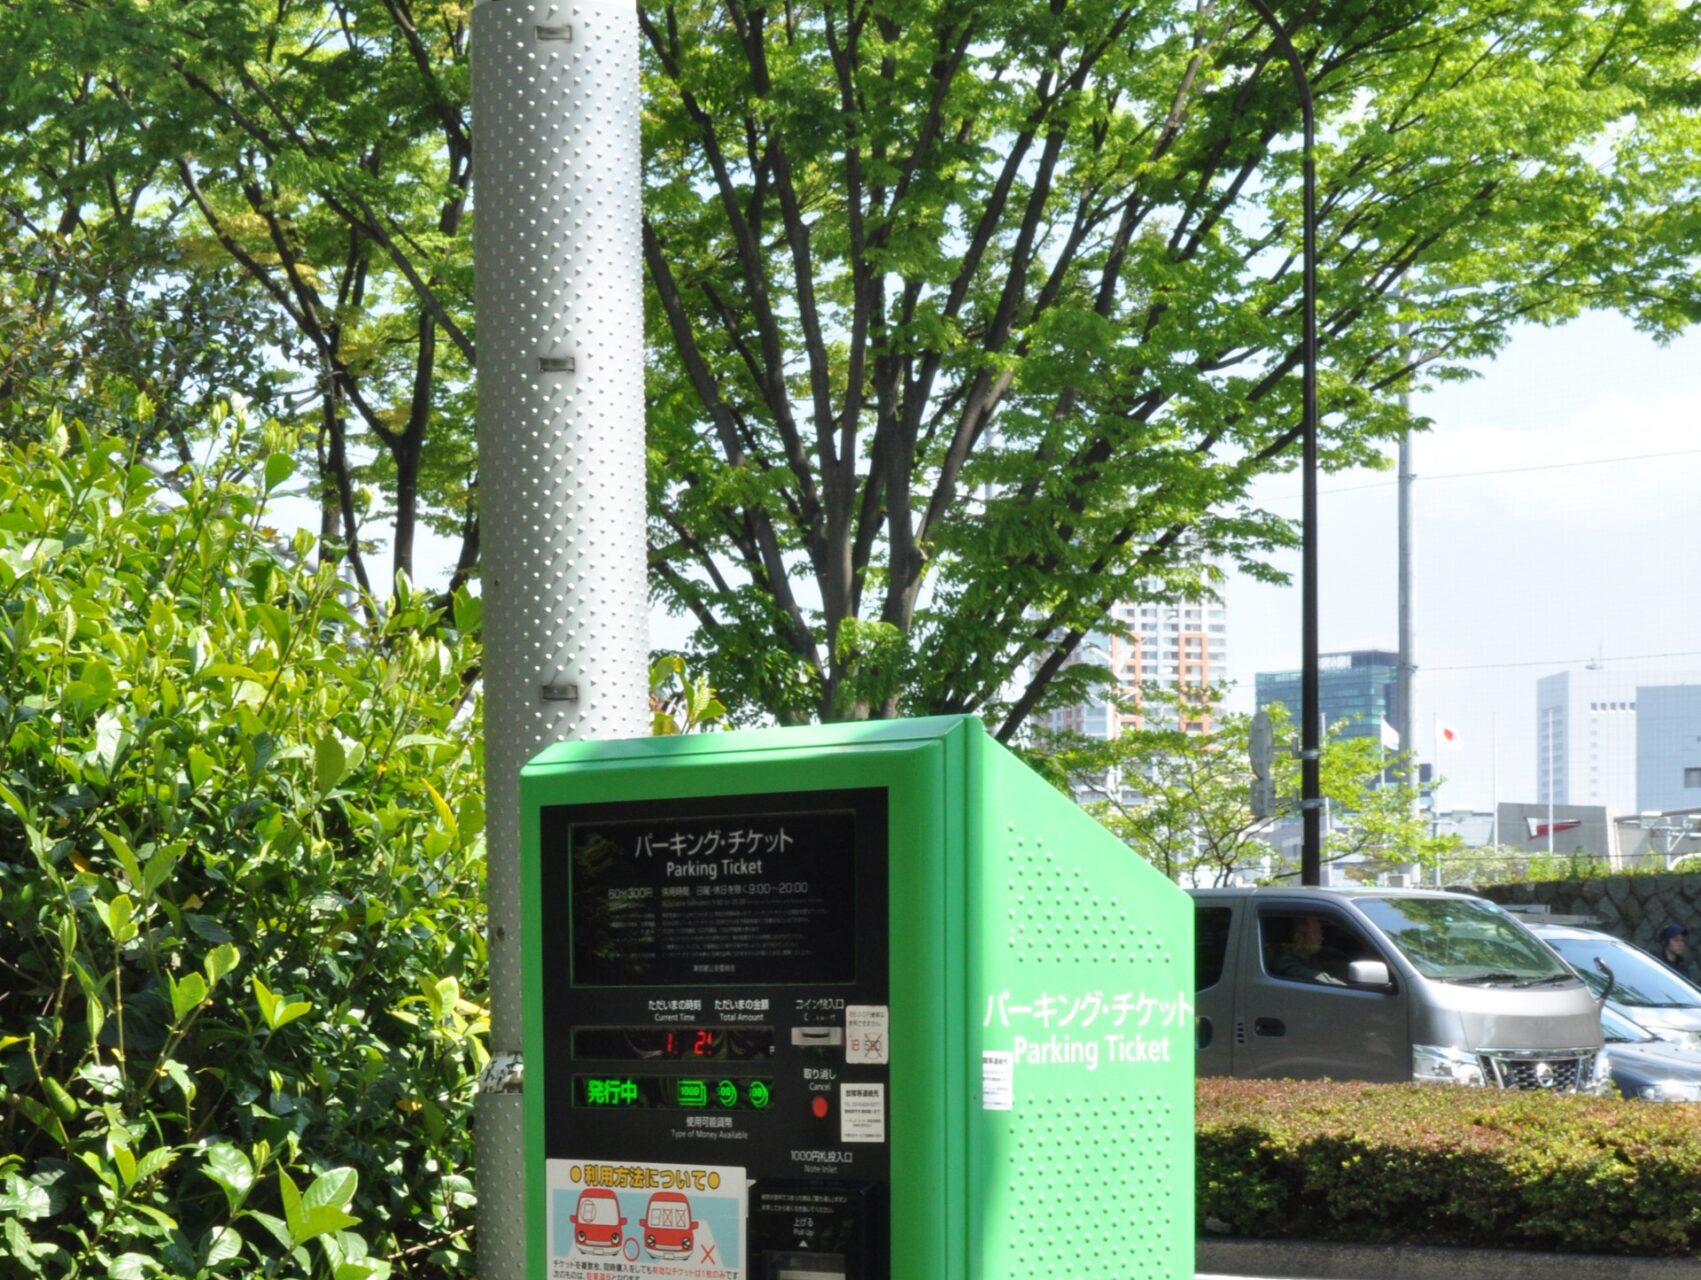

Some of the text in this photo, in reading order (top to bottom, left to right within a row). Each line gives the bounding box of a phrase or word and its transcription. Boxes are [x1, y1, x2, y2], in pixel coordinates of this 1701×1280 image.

[635, 827, 794, 858] パーキング・チケット
[666, 857, 763, 880] Parking Ticket
[720, 1013, 737, 1021] Total
[983, 990, 1194, 1028] パーキング・チケット
[1013, 1034, 1170, 1071] Parking Ticket
[803, 1067, 836, 1080] 取り消し
[588, 1080, 638, 1104] 発行中
[583, 1163, 707, 1191] 利用方法について
